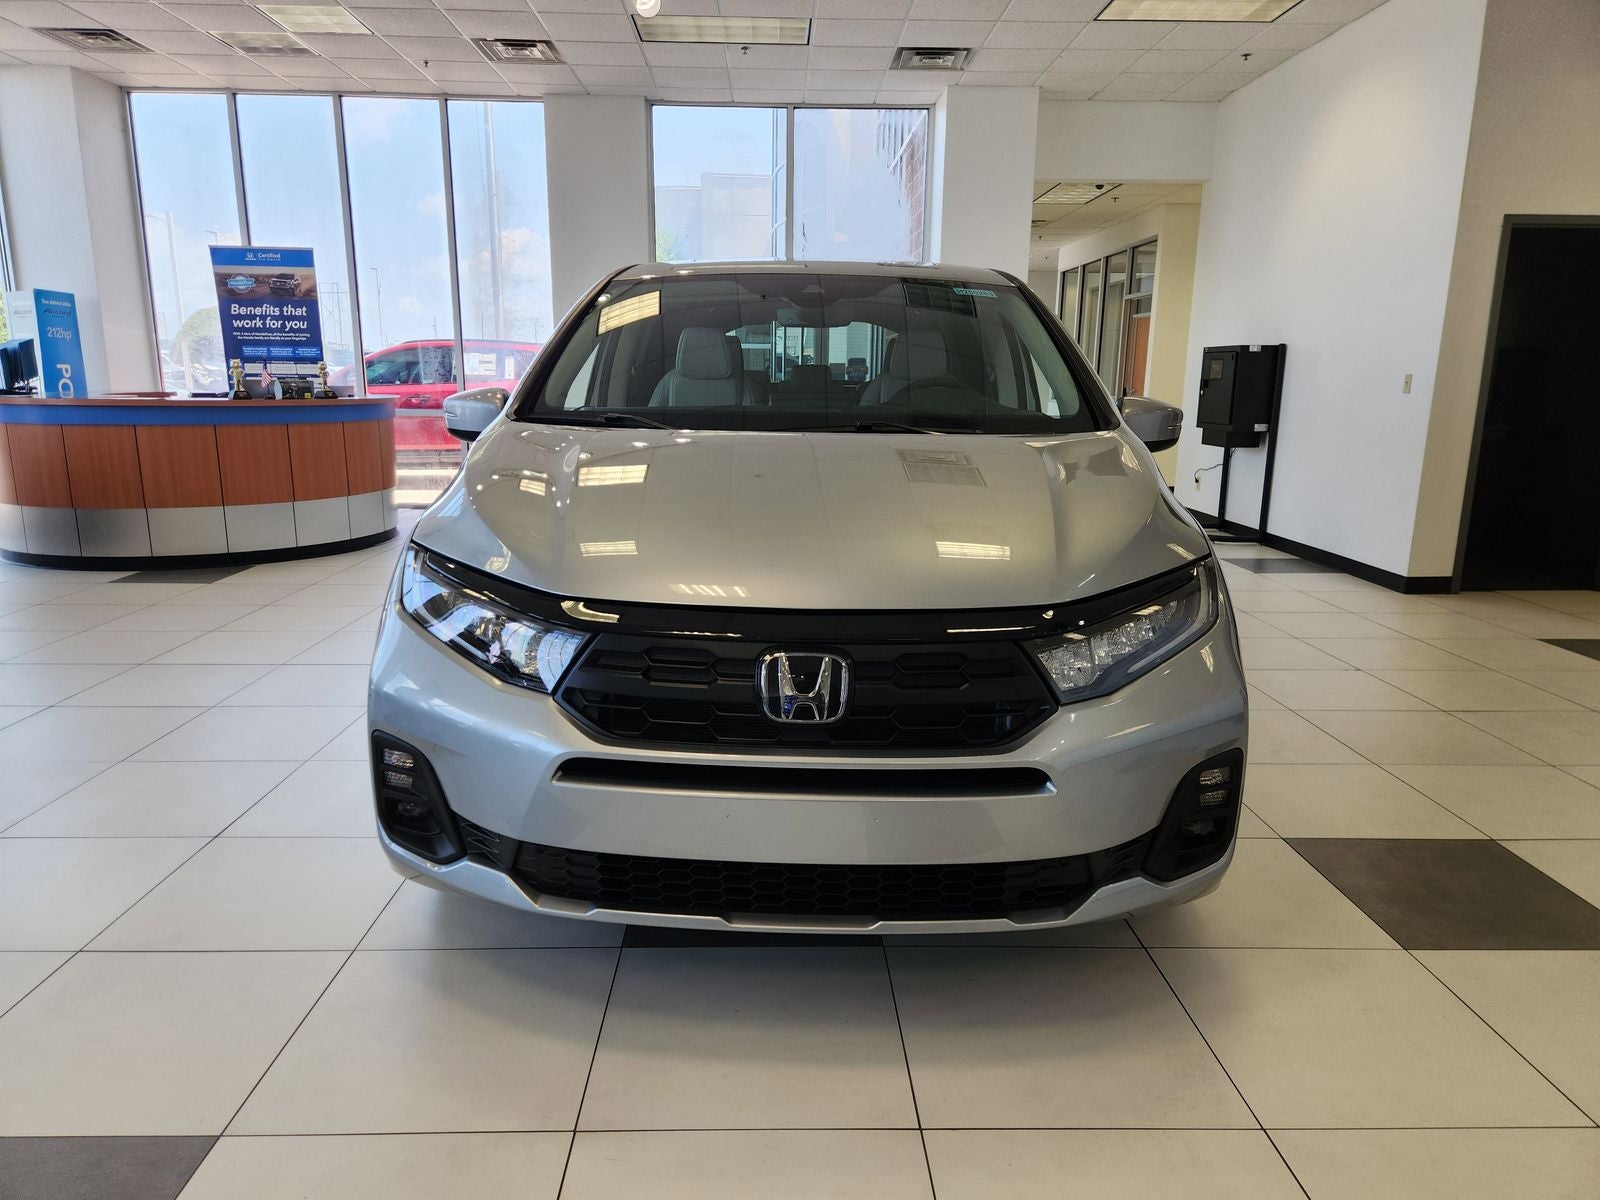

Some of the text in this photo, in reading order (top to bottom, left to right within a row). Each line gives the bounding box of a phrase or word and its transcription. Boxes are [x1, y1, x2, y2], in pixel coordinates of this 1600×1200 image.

[231, 304, 307, 316] Benefits that
[233, 317, 307, 331] work for you
[47, 327, 72, 341] 212hp
